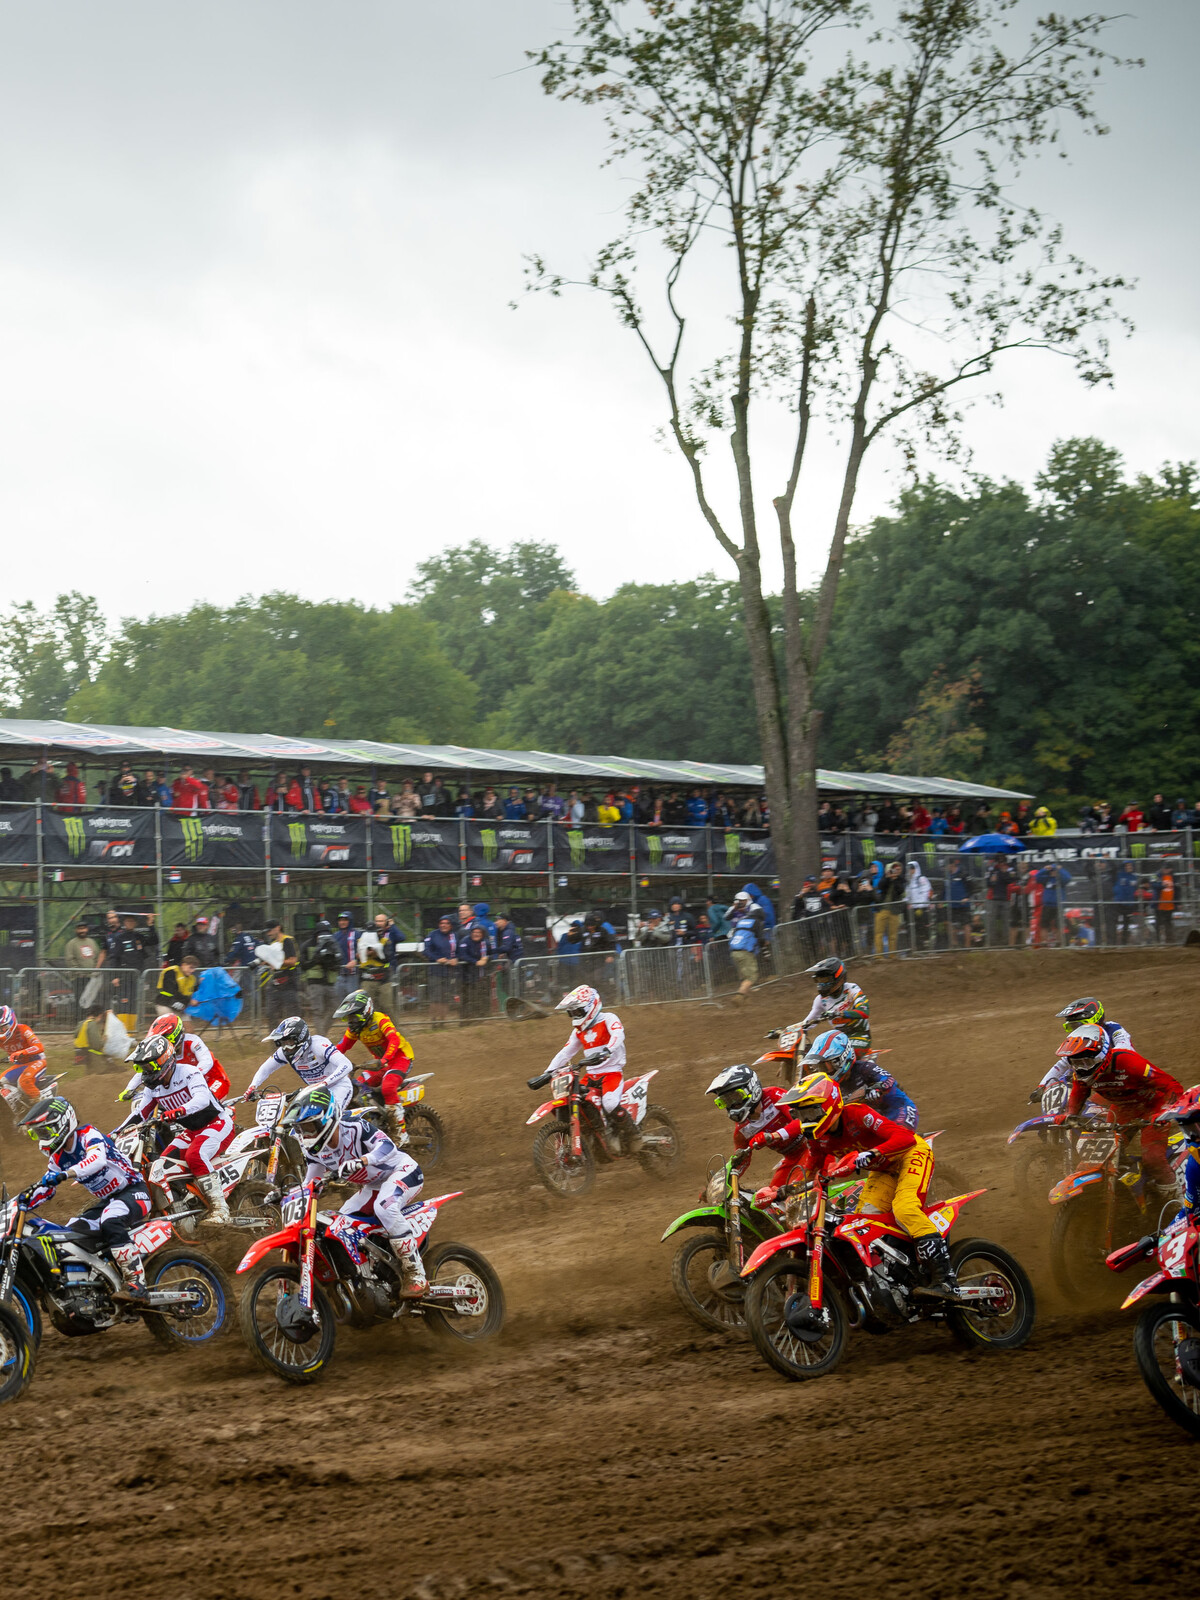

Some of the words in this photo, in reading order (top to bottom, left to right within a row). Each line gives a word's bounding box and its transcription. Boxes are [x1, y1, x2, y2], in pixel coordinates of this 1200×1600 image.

[632, 1086, 647, 1101] 42
[258, 1104, 278, 1120] 35
[1080, 1139, 1113, 1160] 69
[219, 1165, 240, 1186] 45
[282, 1198, 307, 1225] 103
[1165, 1231, 1188, 1268] 3
[0, 1267, 9, 1300] DUNLOP
